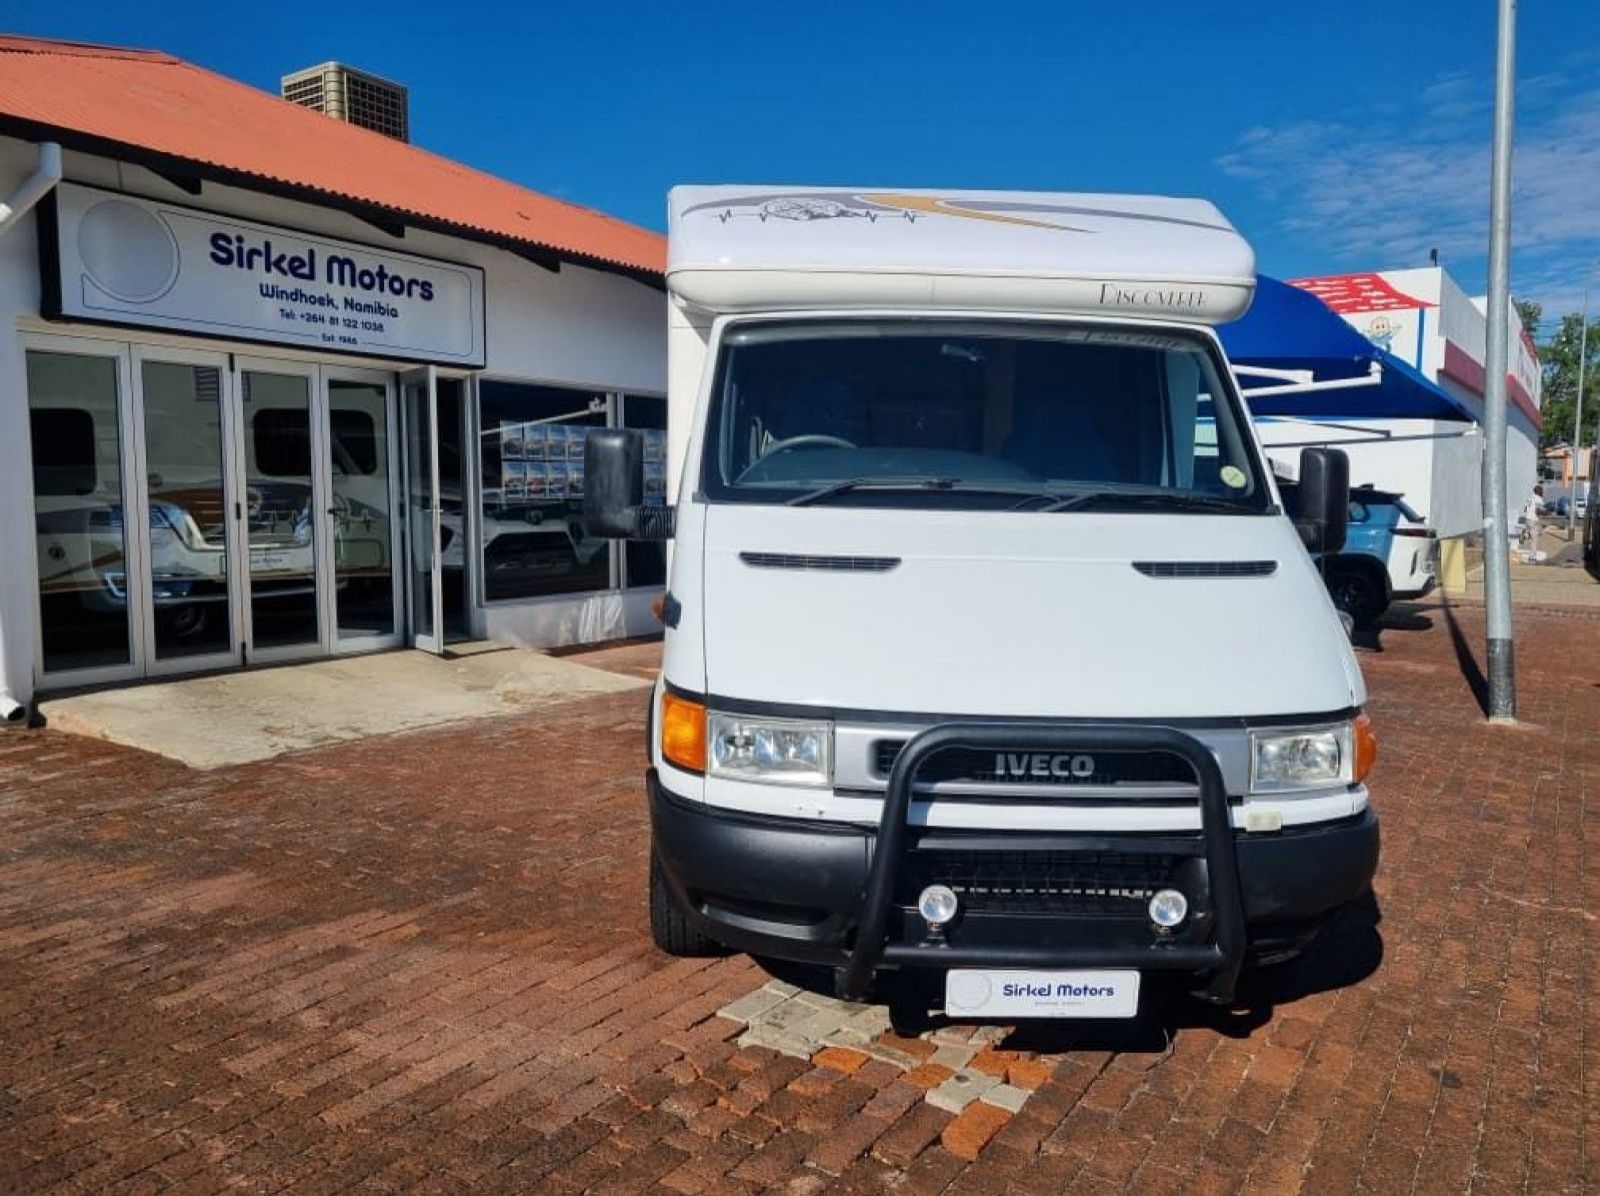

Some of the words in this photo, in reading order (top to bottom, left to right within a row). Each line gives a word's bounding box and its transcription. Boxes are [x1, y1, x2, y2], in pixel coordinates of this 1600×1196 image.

[210, 232, 316, 281] Sirkel
[326, 255, 434, 301] Motors
[259, 283, 339, 310] Windhoek,
[344, 300, 399, 318] Namibia
[342, 317, 358, 329] 122
[995, 753, 1095, 777] IVECO
[1002, 983, 1051, 997] Sirkel
[1056, 983, 1115, 997] Motors
